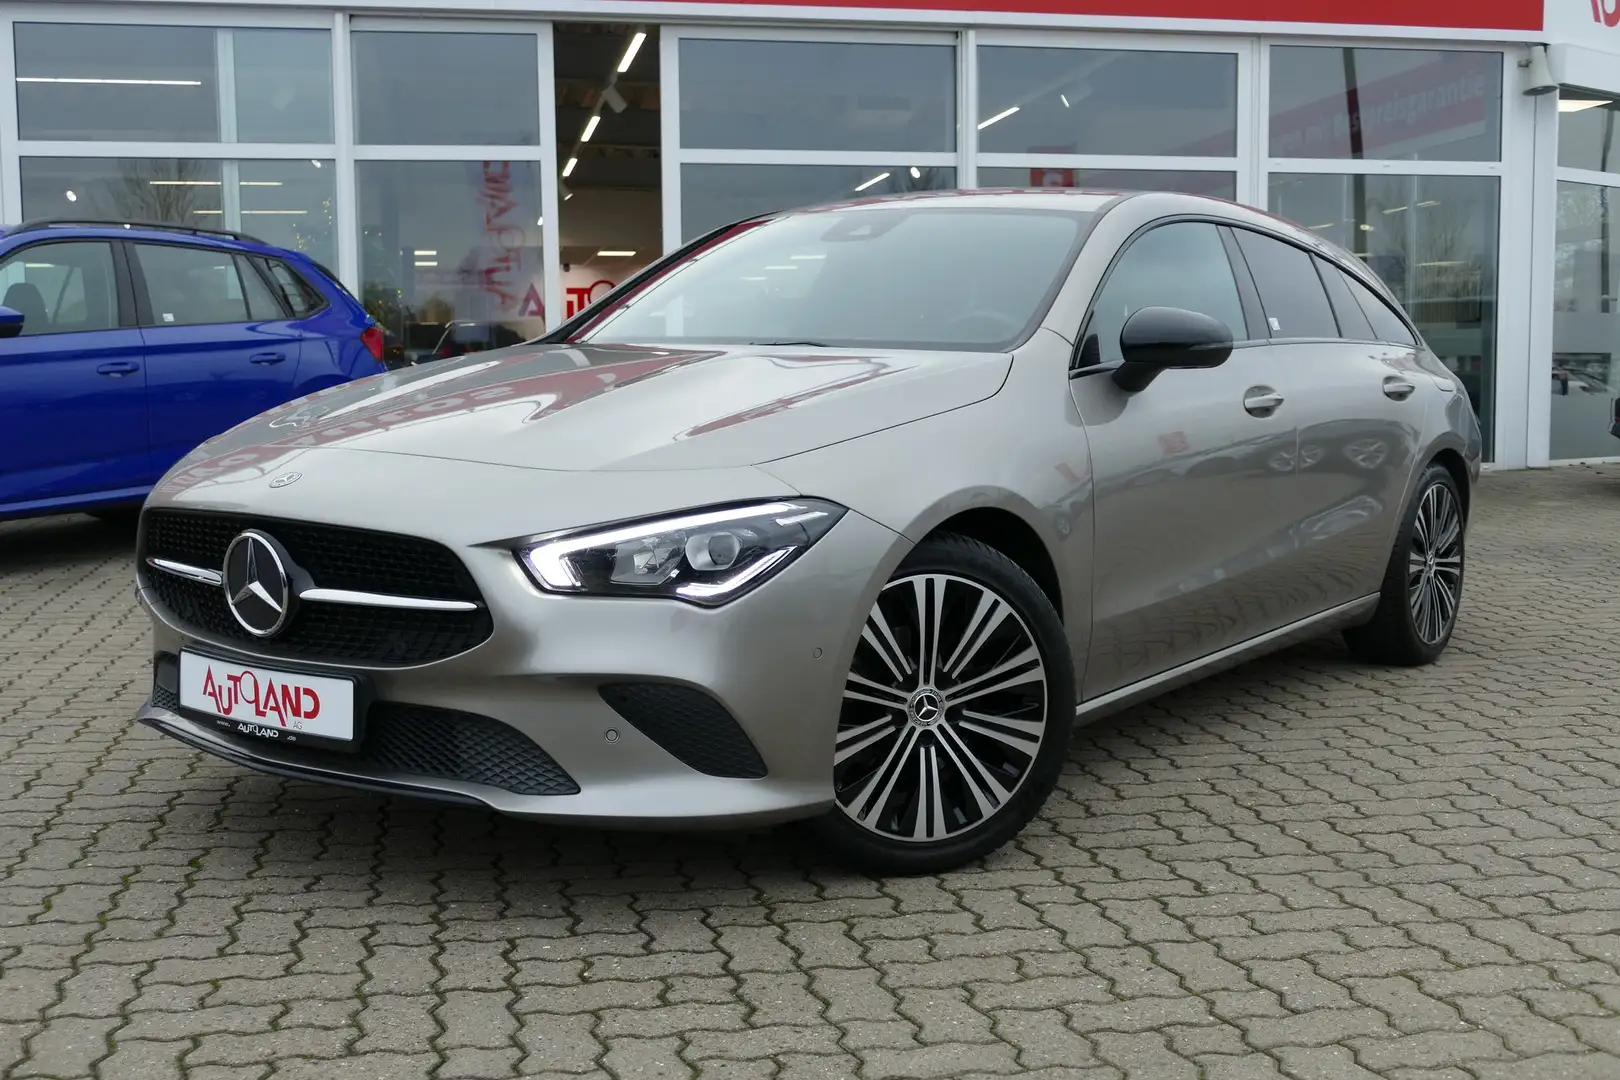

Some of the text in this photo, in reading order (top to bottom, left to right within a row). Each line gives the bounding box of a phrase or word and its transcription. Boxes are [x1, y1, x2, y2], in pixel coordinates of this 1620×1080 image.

[202, 665, 321, 727] AUTOLAND
[237, 723, 279, 738] AUTOLAND
[292, 720, 303, 730] AG
